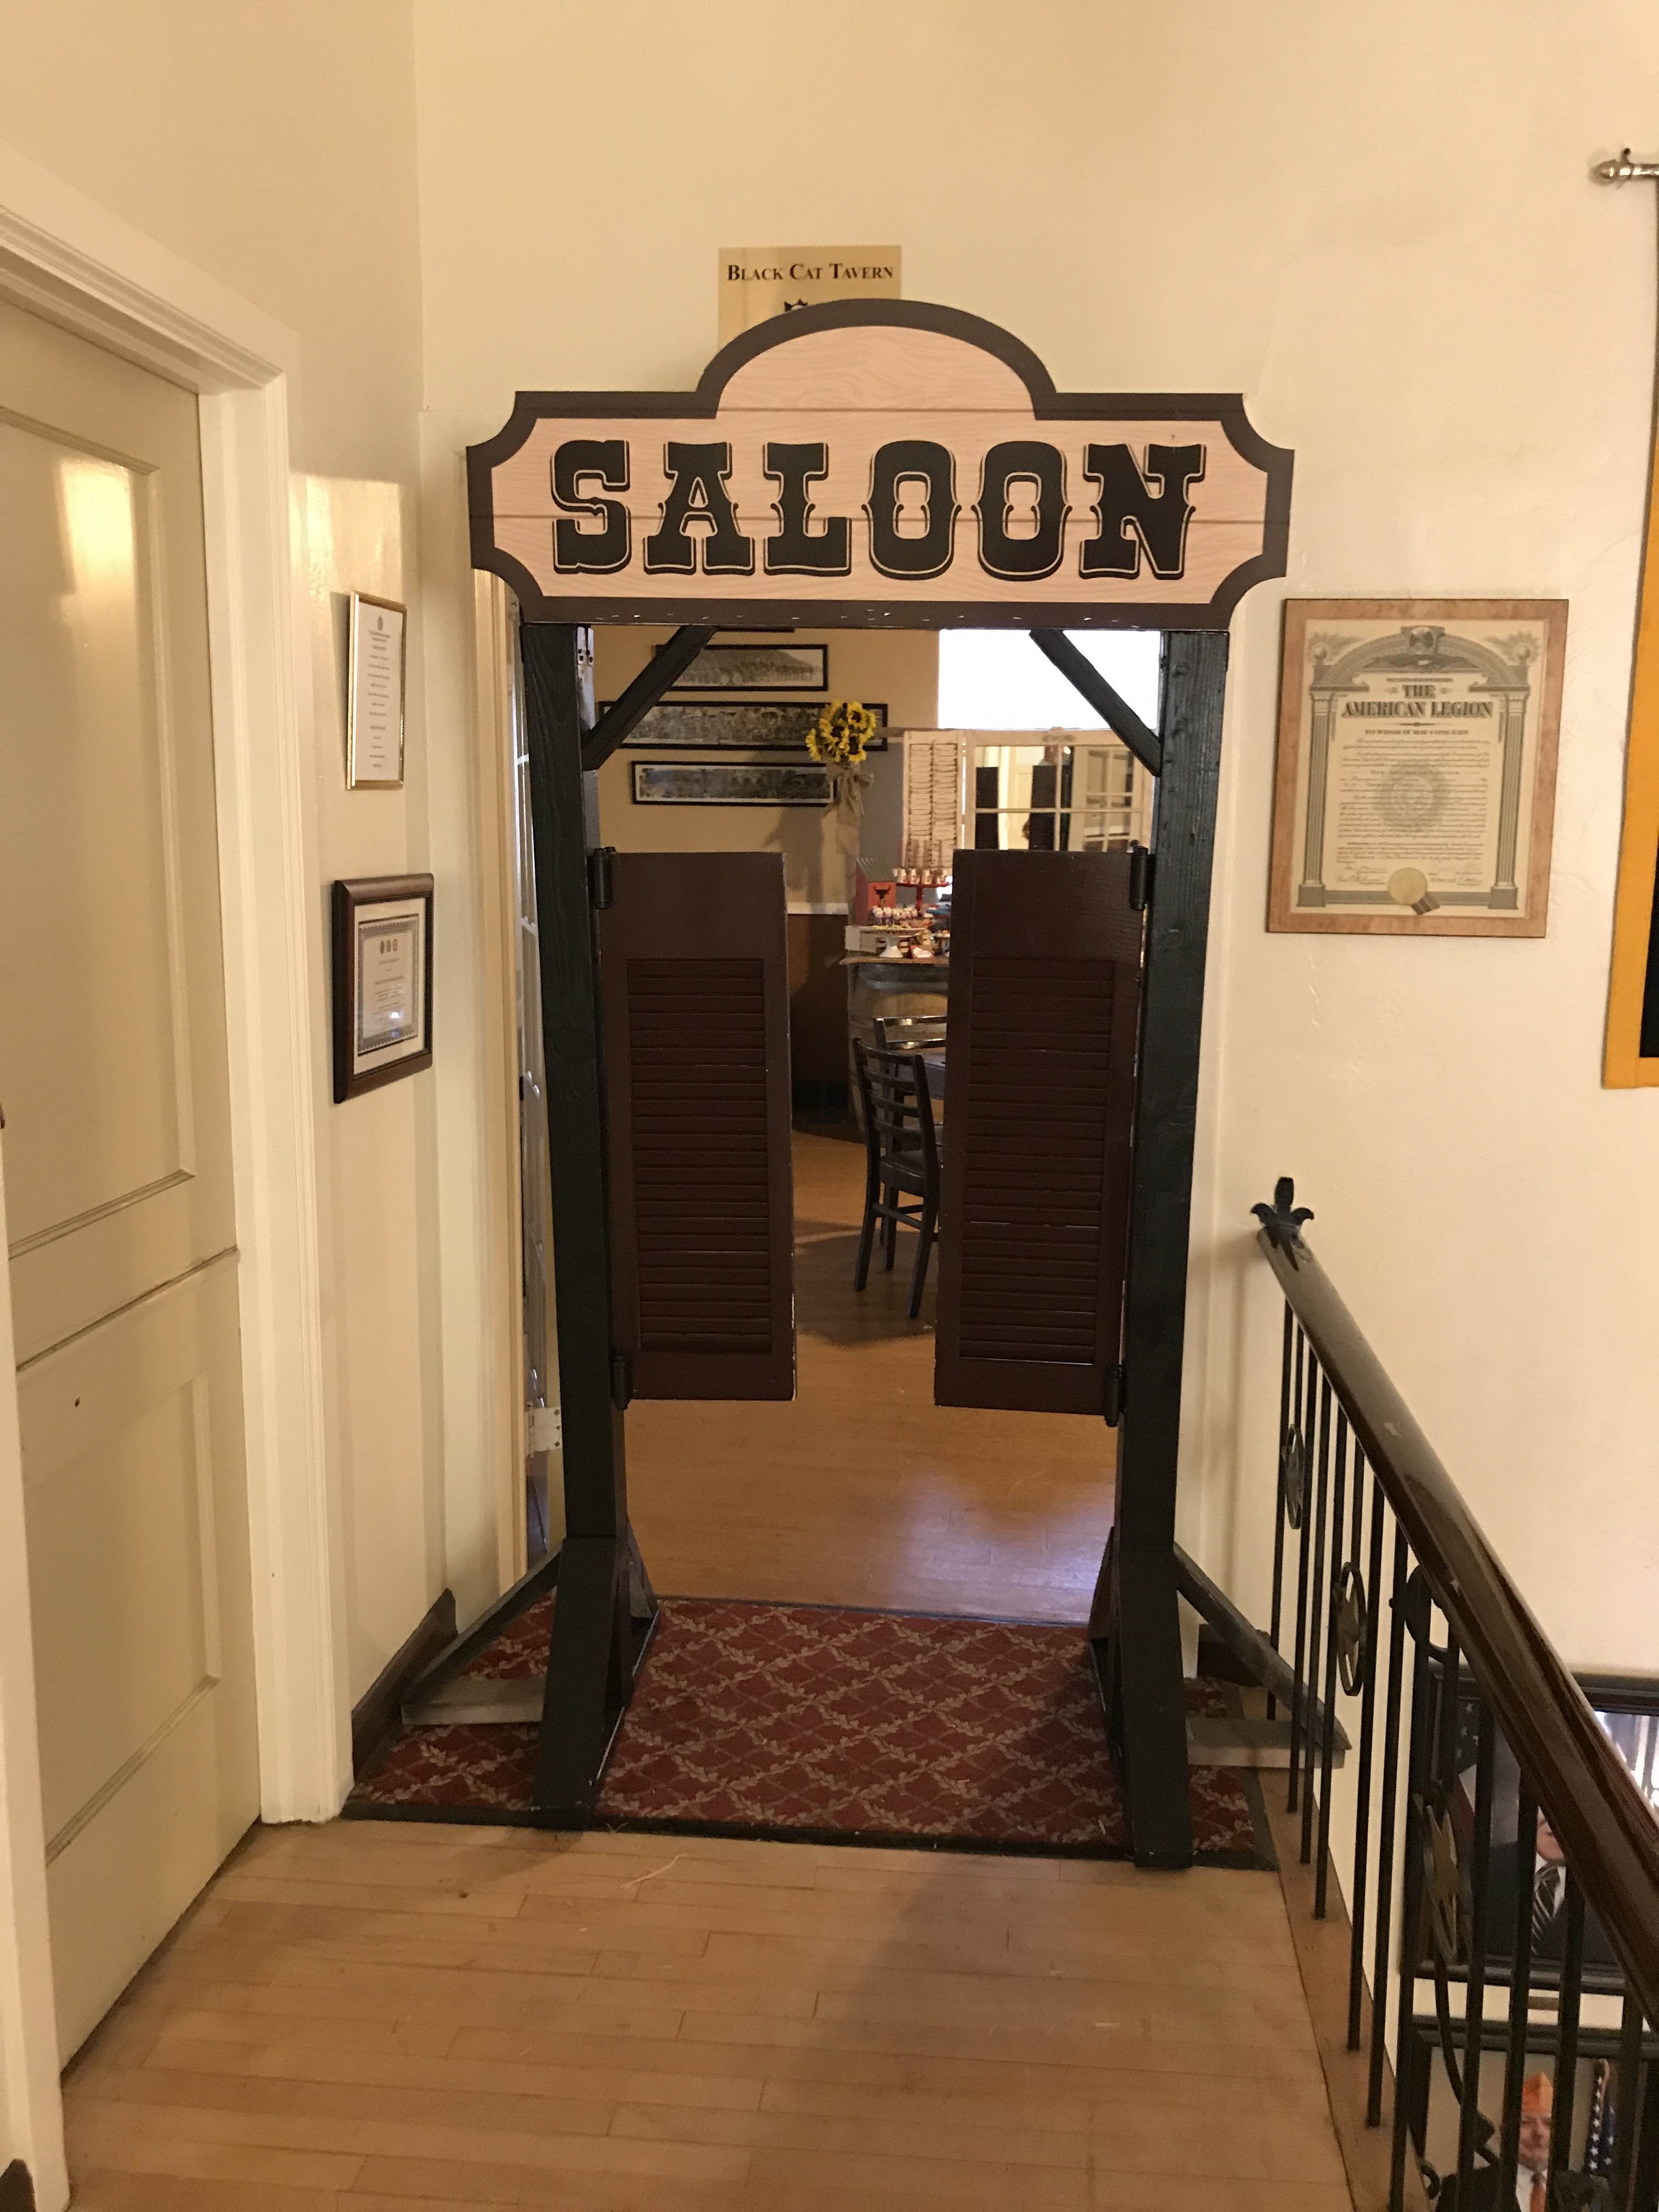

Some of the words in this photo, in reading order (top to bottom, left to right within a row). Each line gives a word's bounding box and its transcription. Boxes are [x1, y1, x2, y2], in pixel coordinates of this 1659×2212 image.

[789, 263, 823, 280] CAT
[551, 439, 1206, 580] SALOON
[1402, 685, 1436, 698] THE
[1341, 701, 1427, 718] AMERICAN
[1430, 701, 1494, 718] LEGION
